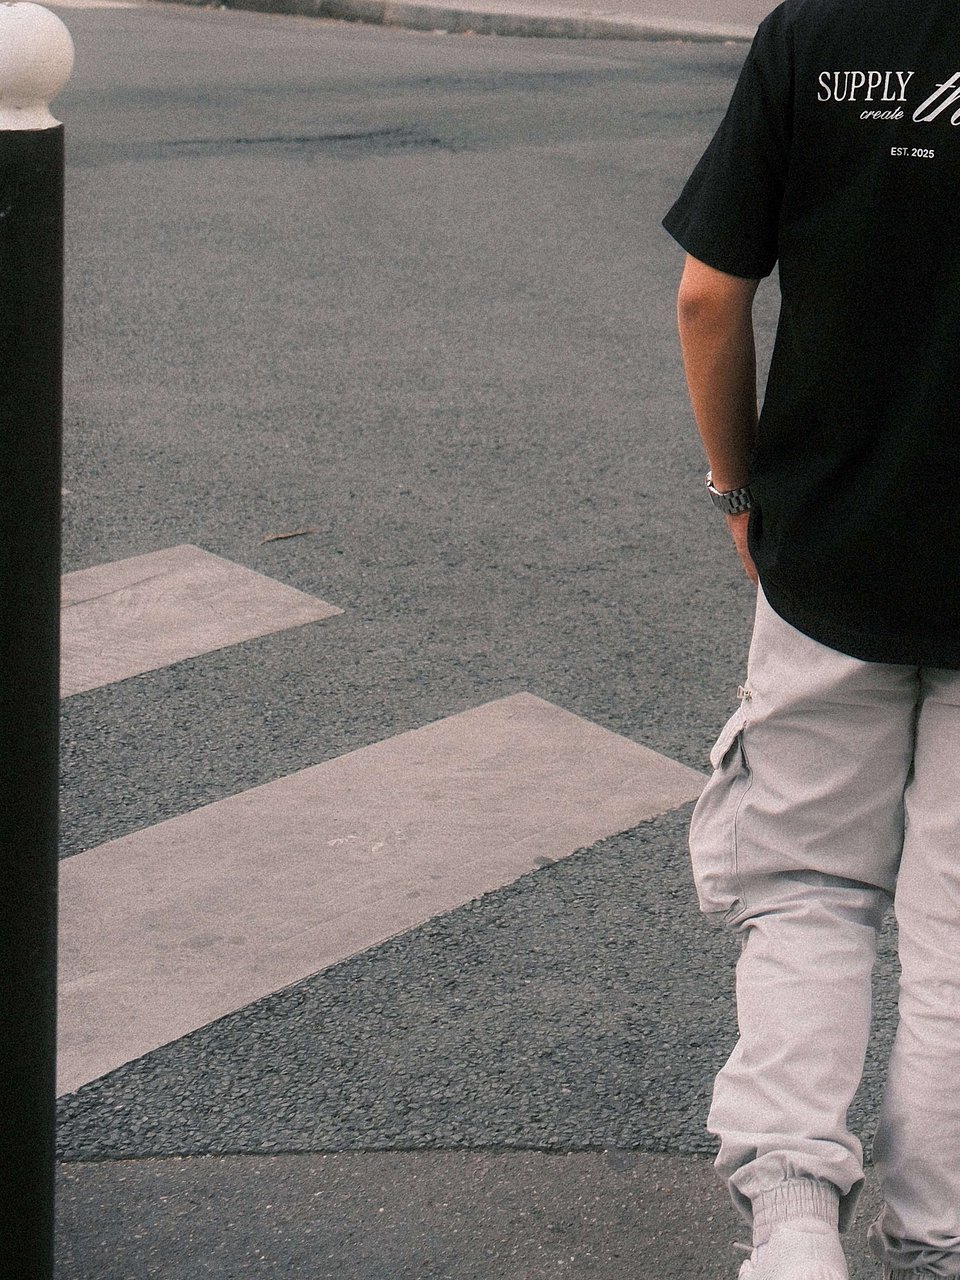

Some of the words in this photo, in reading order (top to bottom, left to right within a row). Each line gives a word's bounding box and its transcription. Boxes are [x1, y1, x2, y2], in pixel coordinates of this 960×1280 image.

[817, 70, 915, 102] SUPPLY
[859, 106, 904, 121] create
[890, 146, 910, 157] EST.
[911, 147, 935, 159] 2025
